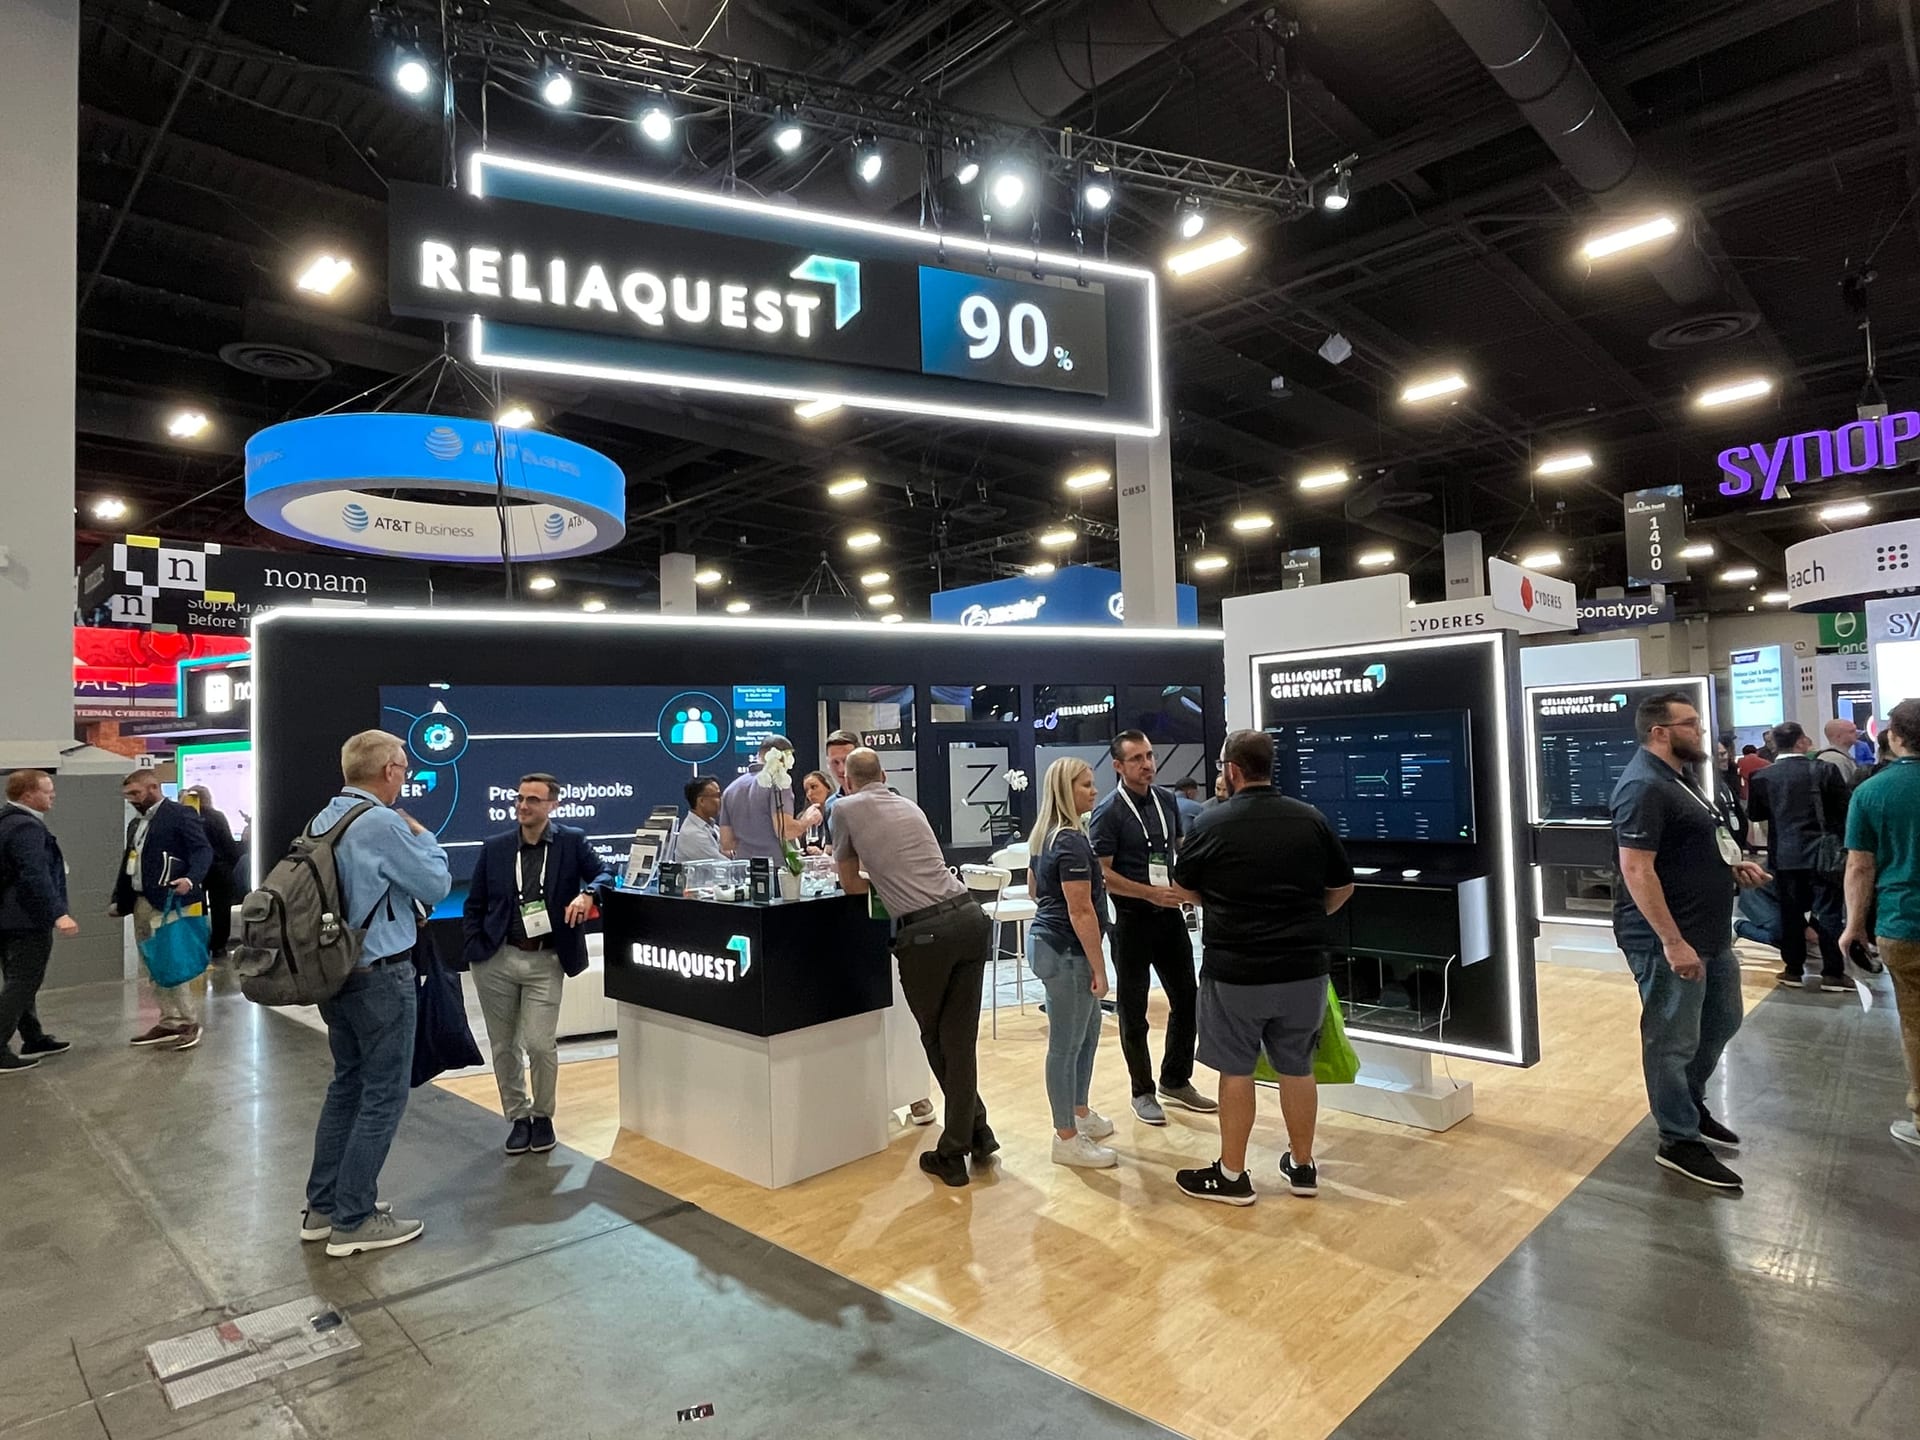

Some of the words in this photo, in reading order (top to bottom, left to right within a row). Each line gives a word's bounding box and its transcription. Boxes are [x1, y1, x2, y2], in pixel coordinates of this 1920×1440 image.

[419, 240, 822, 338] RELIAQUEST
[375, 517, 411, 532] AT&T
[415, 521, 474, 537] Business
[168, 557, 198, 582] n
[264, 568, 367, 594] nonam
[1534, 590, 1562, 609] CYDERES
[188, 613, 236, 628] Before
[1576, 603, 1659, 619] sonatype
[1271, 668, 1342, 684] RELIAQUEST
[1270, 678, 1373, 698] GREYMATTER
[1058, 703, 1109, 716] RELIAQUEST
[1541, 695, 1594, 706] RELIAQUEST
[1541, 703, 1617, 715] GREYMATTER
[558, 782, 634, 801] playbooks
[489, 808, 507, 821] to
[632, 943, 736, 982] RELIAQUEST
